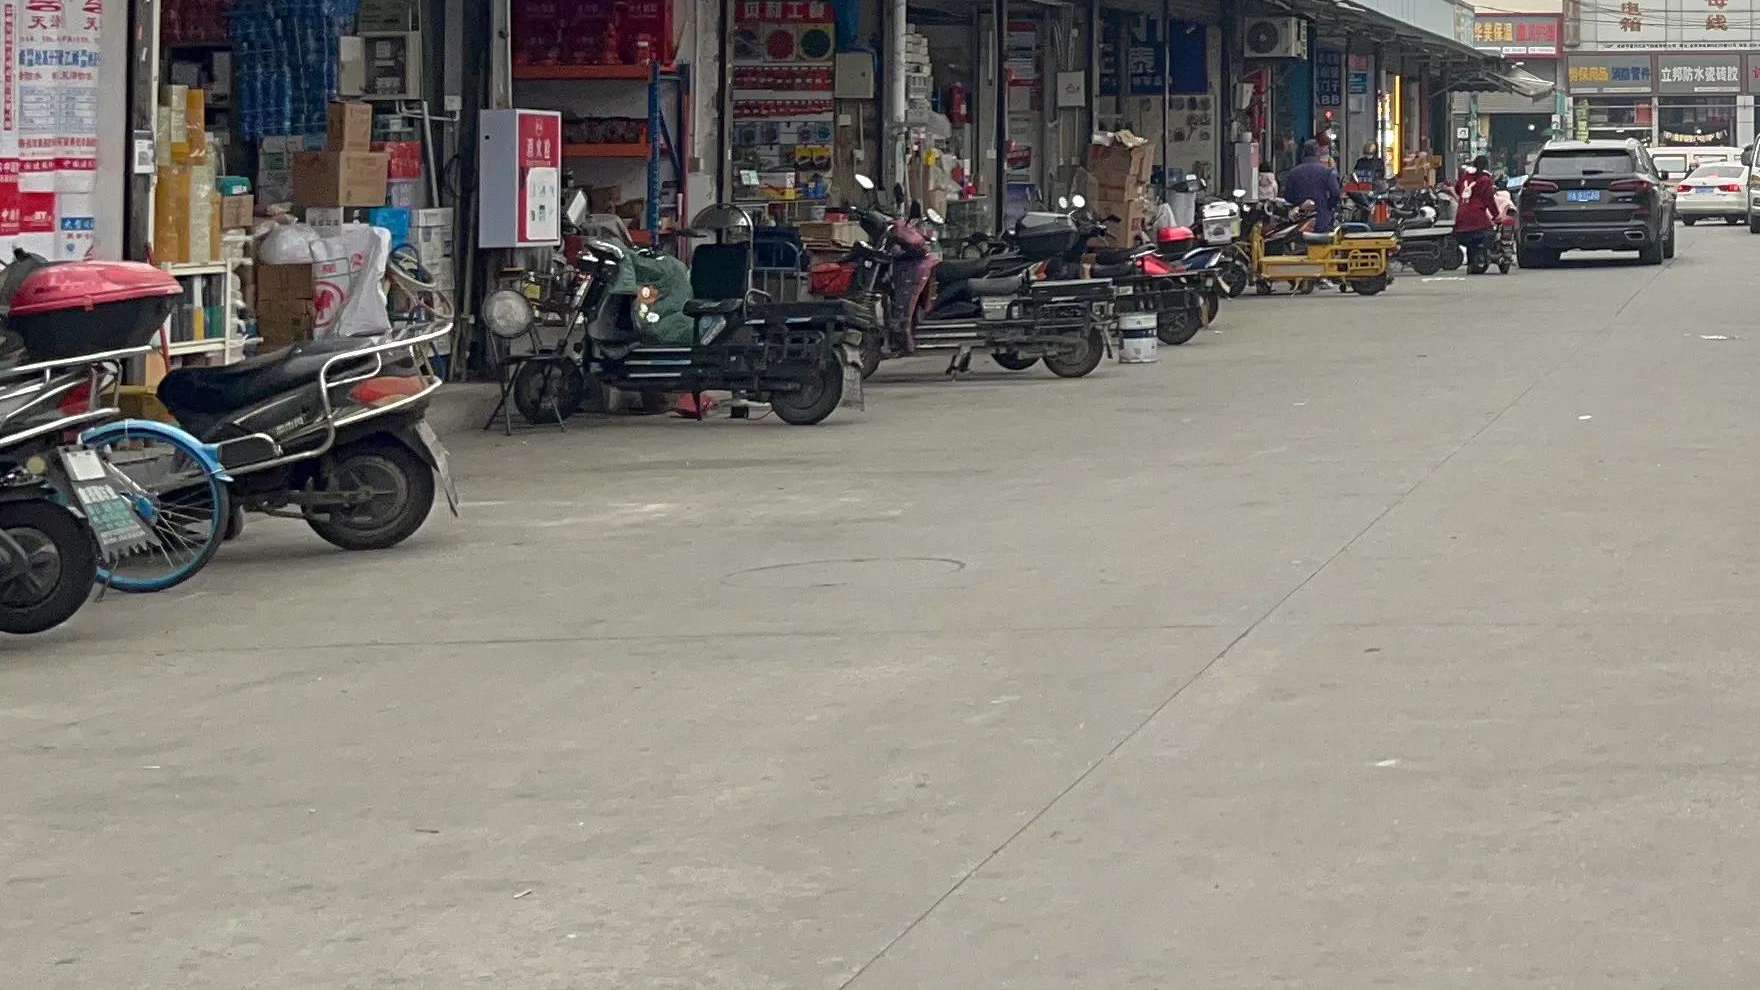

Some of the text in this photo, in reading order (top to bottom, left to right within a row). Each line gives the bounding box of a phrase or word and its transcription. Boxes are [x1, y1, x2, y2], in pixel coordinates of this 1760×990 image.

[1661, 65, 1738, 82] 立邦防水瓷砖胶
